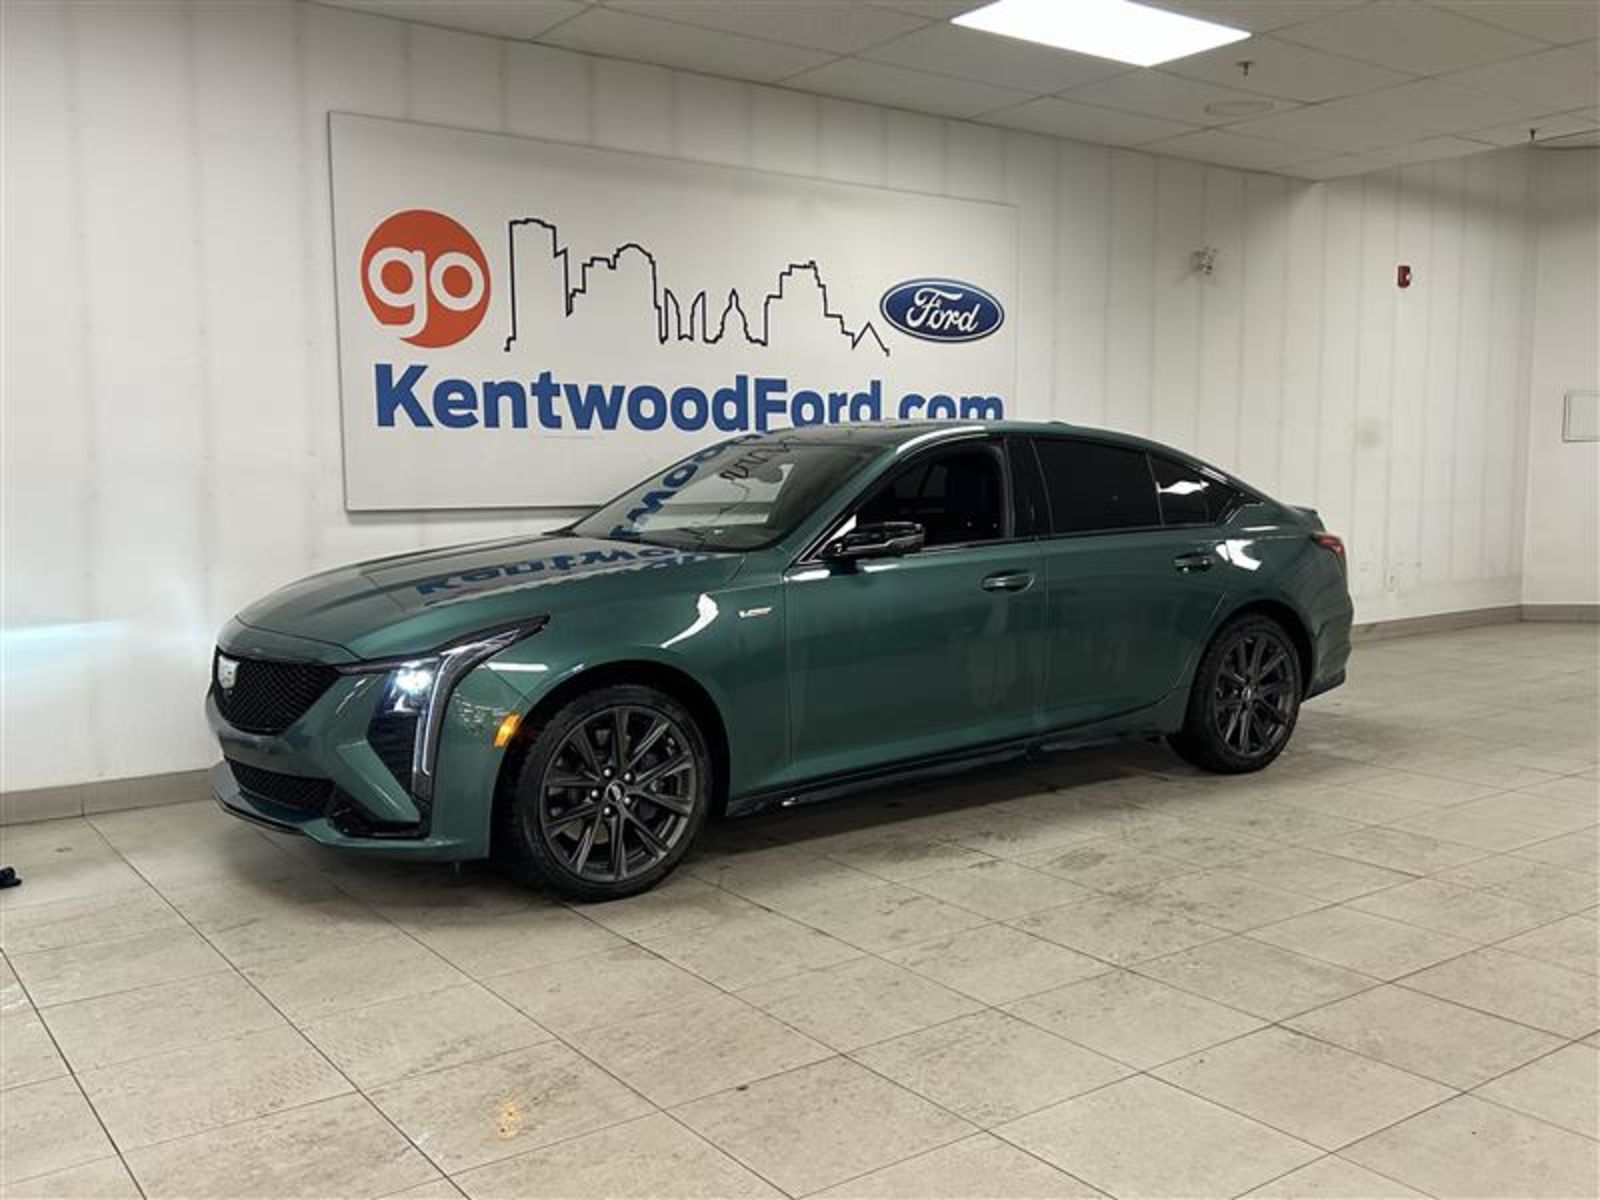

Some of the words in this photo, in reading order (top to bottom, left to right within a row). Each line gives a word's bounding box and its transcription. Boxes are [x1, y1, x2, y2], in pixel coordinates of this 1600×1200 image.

[368, 247, 485, 337] go
[906, 288, 981, 332] Ford
[375, 363, 1003, 433] KentwoodFordcom
